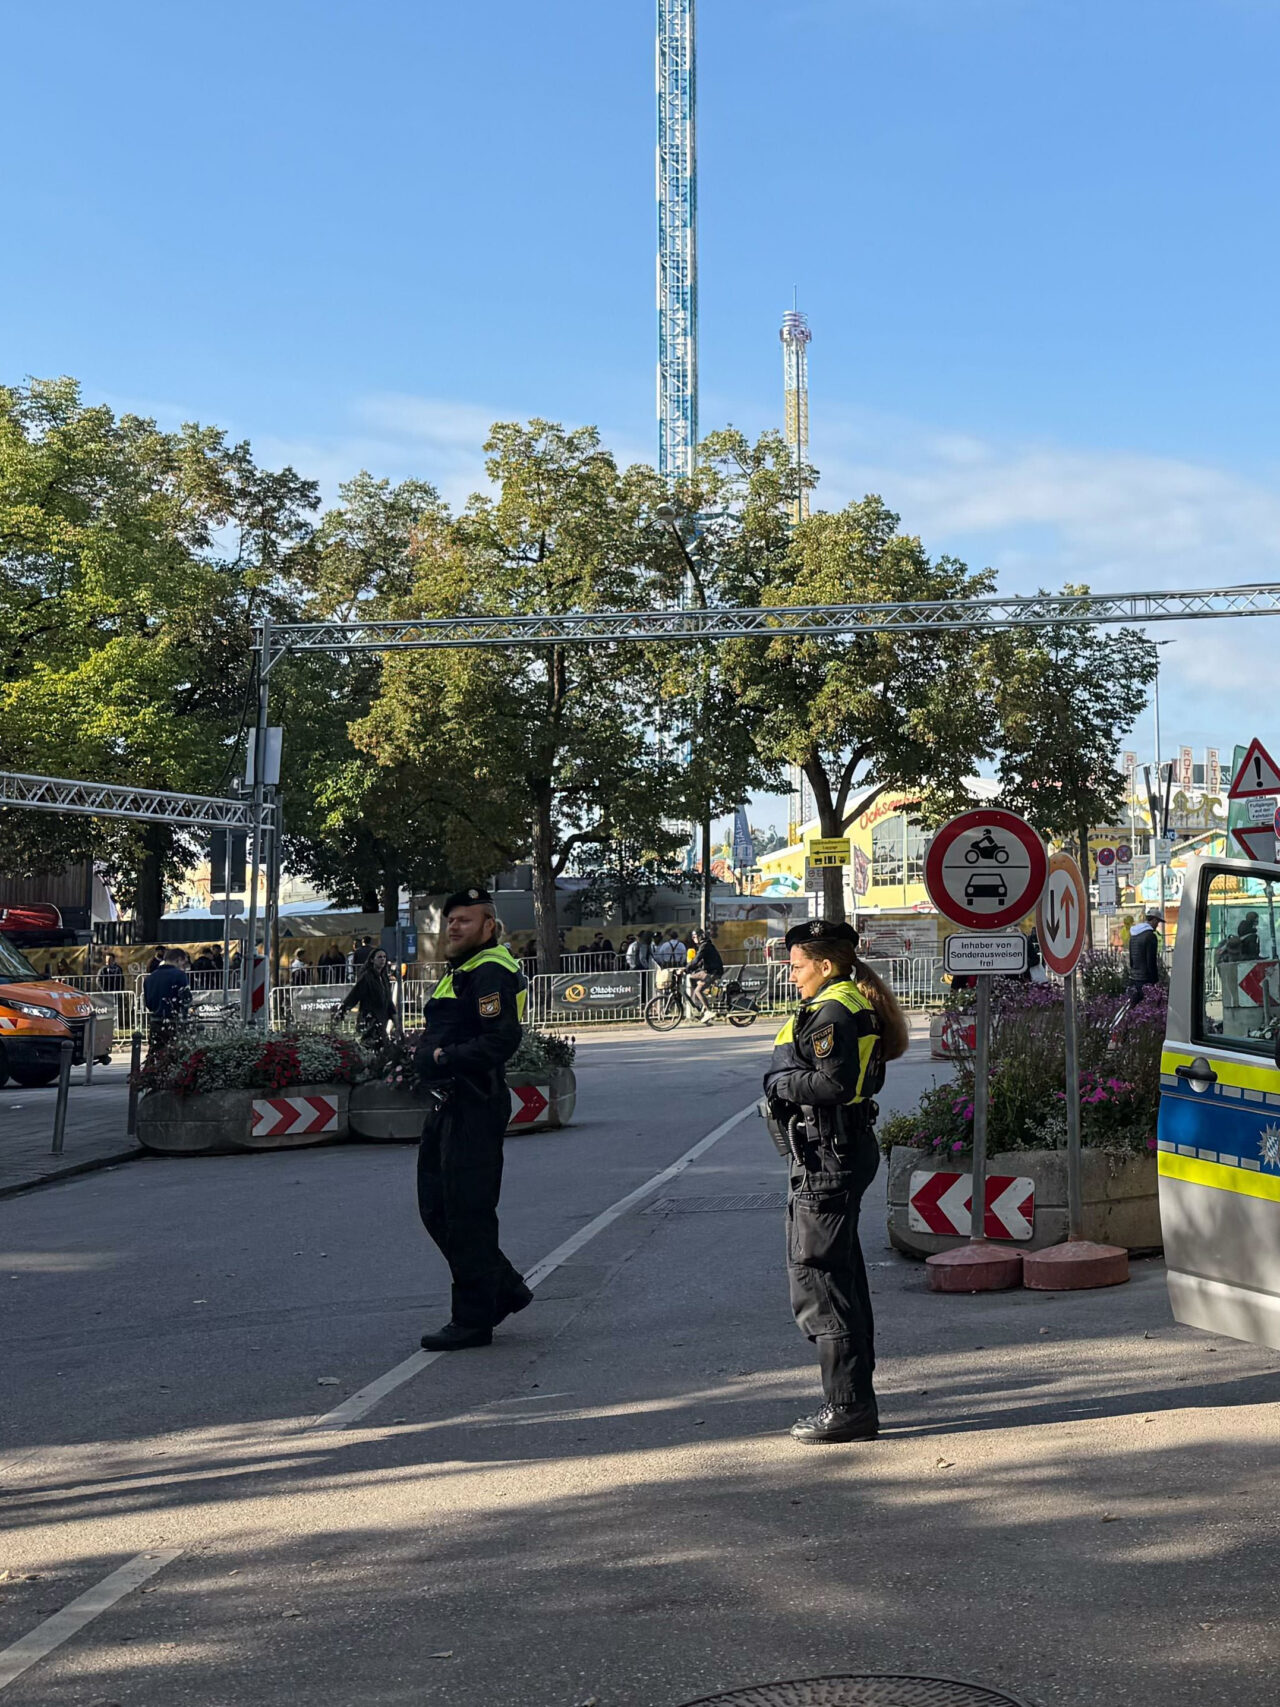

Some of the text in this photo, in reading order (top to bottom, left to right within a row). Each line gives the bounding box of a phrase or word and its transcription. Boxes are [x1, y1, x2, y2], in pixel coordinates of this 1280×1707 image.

[1183, 749, 1191, 792] ROTOR
[1210, 751, 1218, 794] ROTOR
[950, 951, 1023, 959] Sonderausweisen
[590, 985, 632, 994] Oktoberfest
